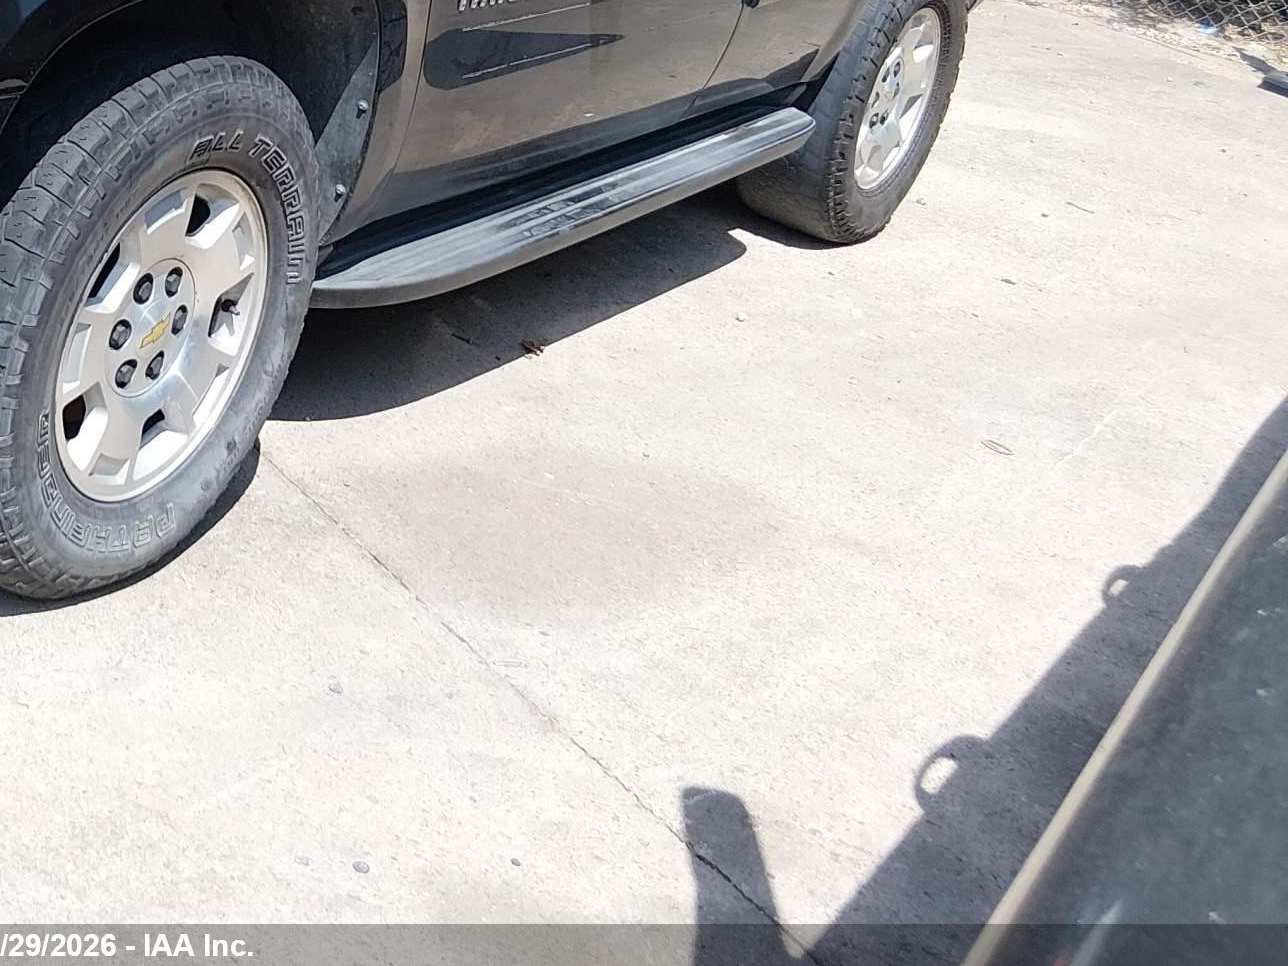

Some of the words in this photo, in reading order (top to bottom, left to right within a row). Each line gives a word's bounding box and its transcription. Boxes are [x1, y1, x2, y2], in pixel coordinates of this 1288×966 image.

[185, 128, 245, 164] ALL
[247, 135, 306, 286] TERRAIN
[35, 408, 177, 555] PATHFINDER
